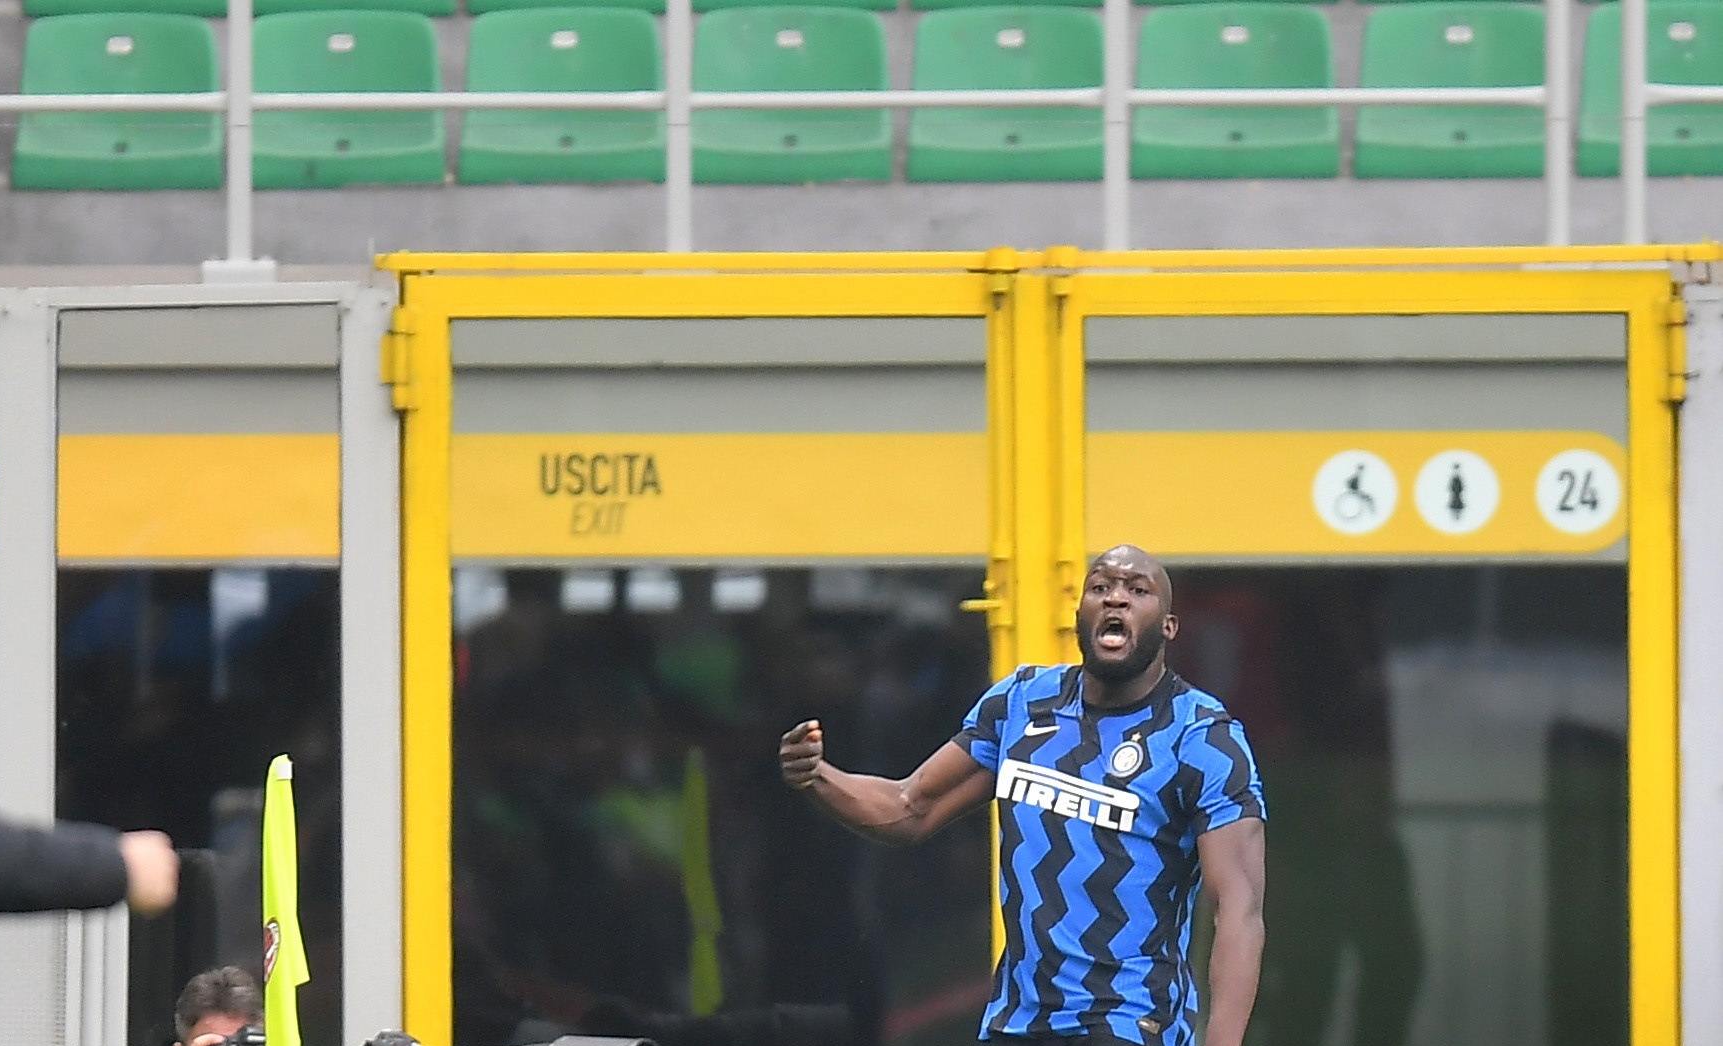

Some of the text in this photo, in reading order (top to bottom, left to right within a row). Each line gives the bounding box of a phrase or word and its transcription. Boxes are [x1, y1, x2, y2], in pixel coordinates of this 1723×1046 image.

[540, 454, 661, 495] USCITA
[1558, 470, 1598, 512] 24
[570, 500, 628, 535] EXIT
[996, 758, 1140, 832] PIRELLI
